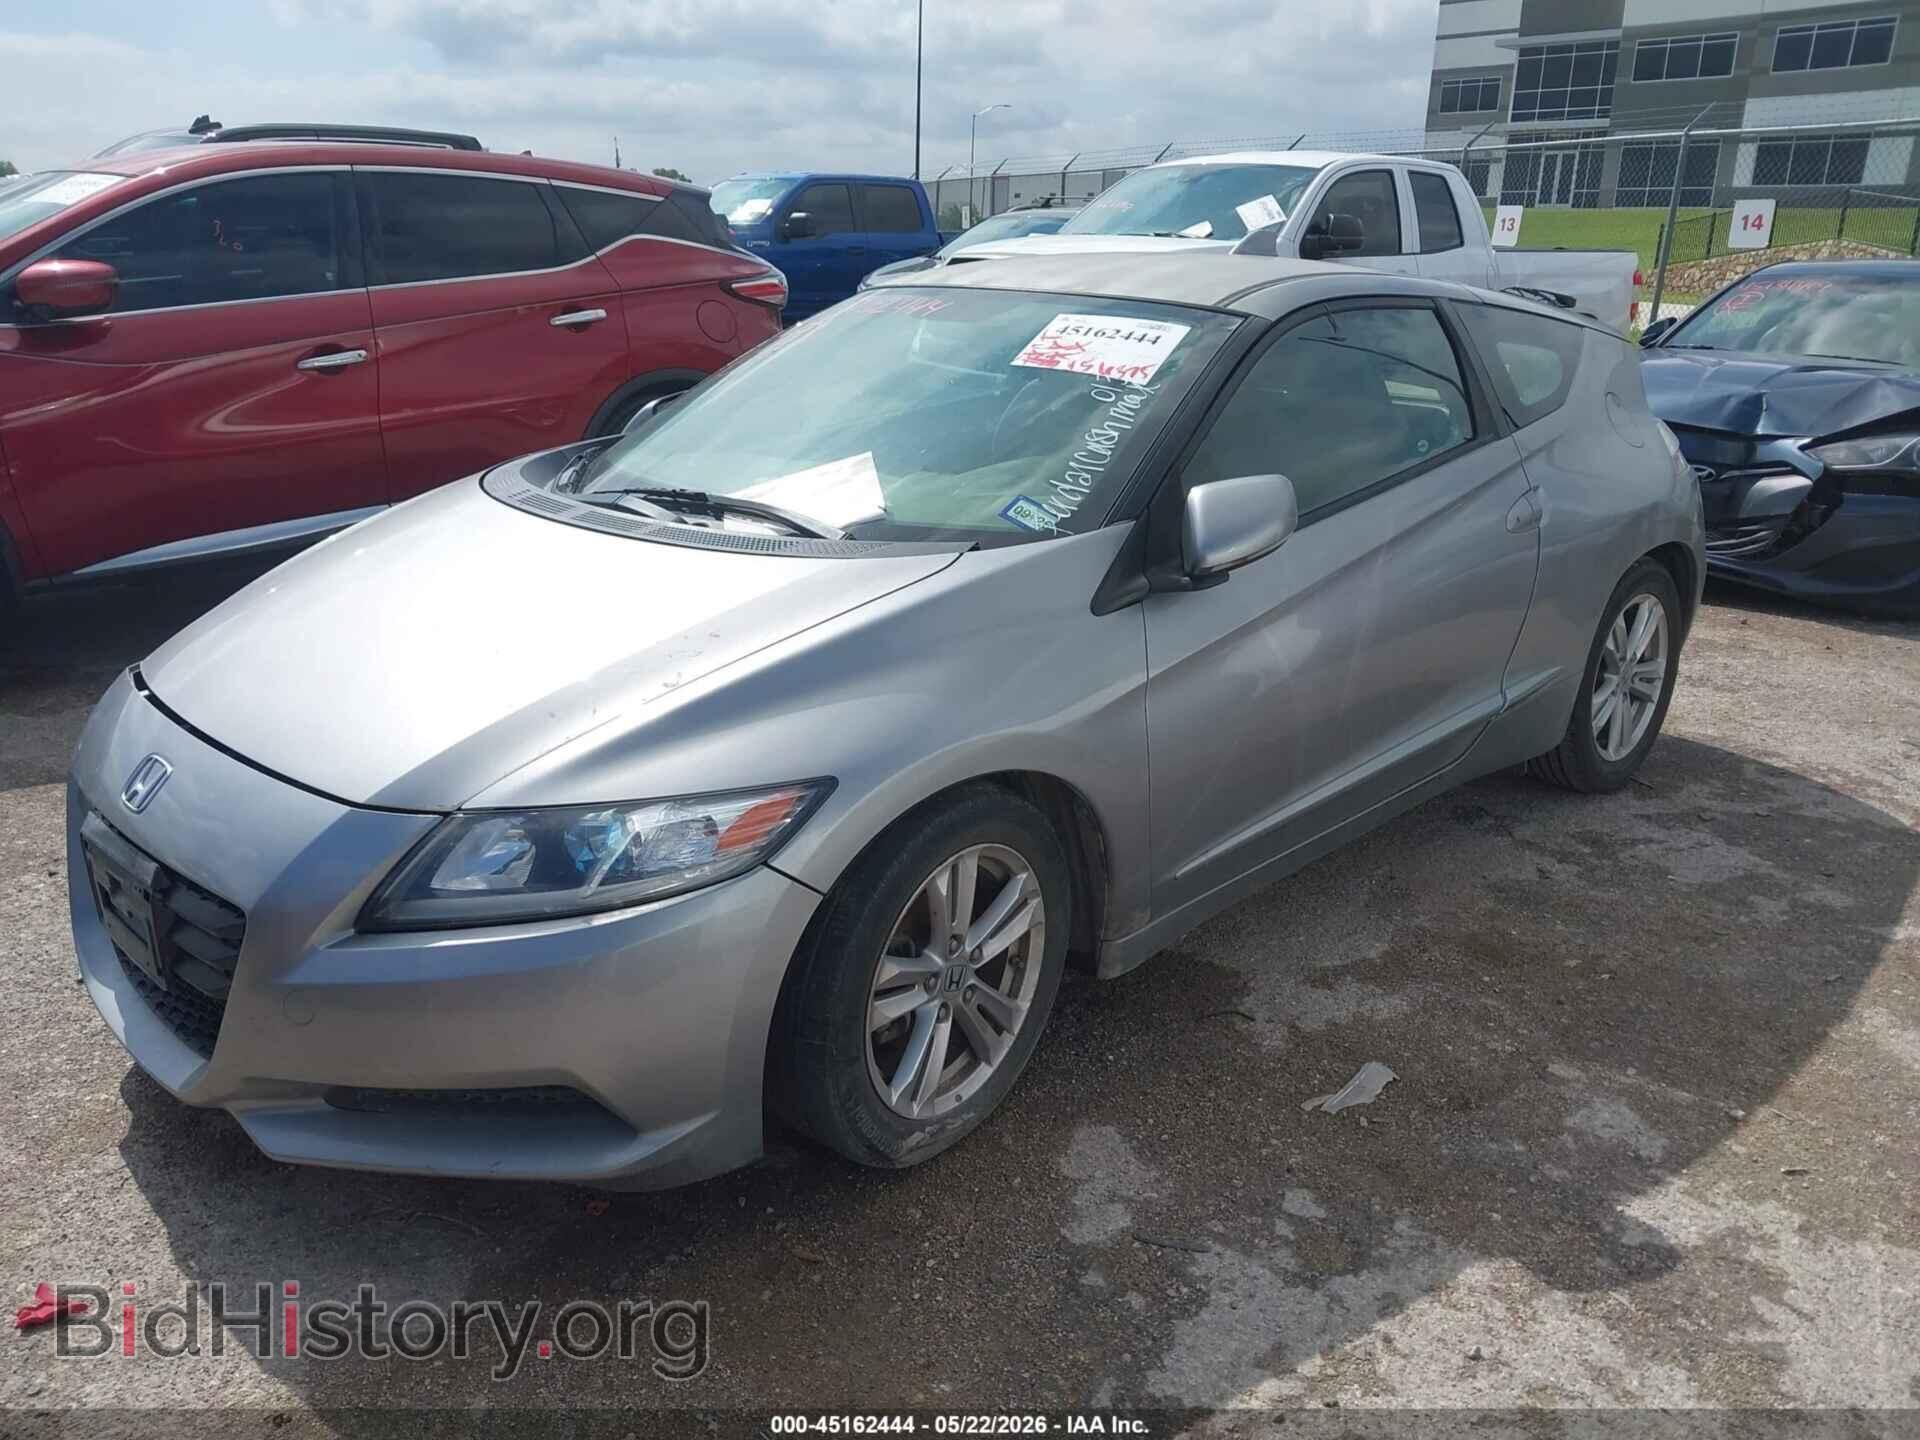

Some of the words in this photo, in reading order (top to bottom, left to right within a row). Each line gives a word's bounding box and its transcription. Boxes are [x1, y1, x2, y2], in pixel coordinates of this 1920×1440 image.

[1501, 217, 1516, 232] 13
[1742, 213, 1764, 231] 14
[1056, 325, 1163, 345] 45162444
